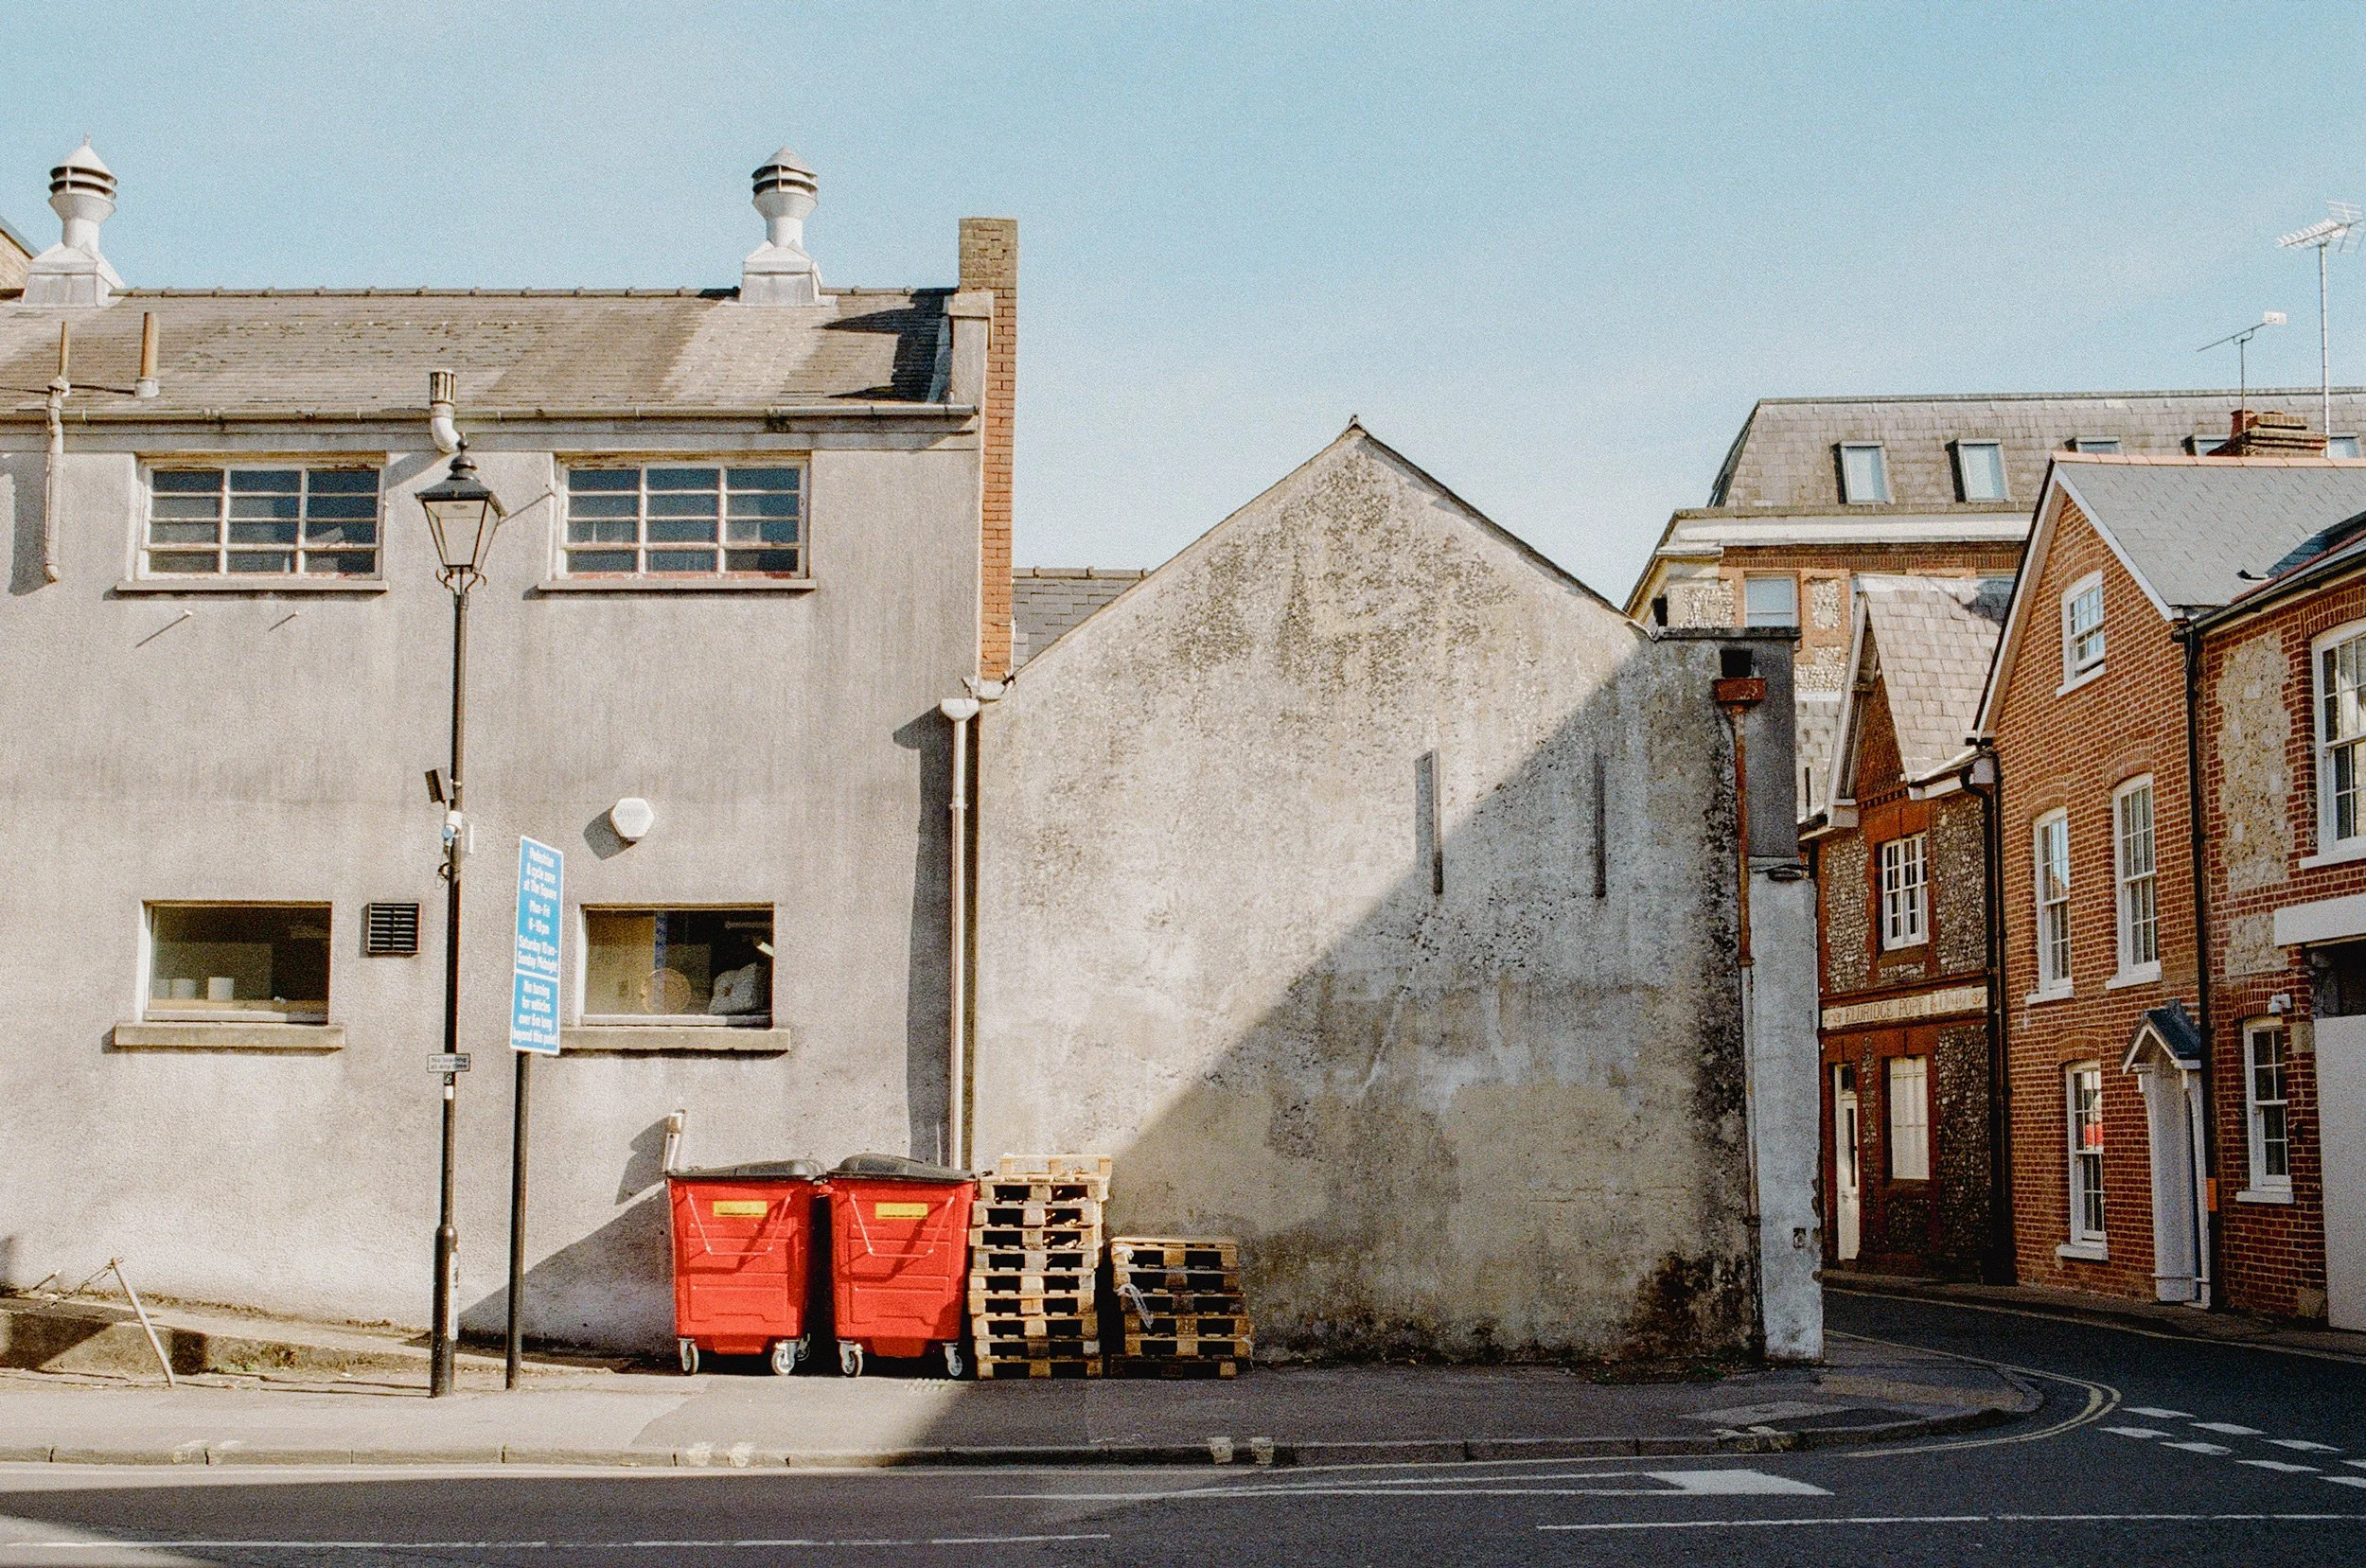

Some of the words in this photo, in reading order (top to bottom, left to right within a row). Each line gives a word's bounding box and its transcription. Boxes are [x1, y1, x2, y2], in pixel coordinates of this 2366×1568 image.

[518, 950, 537, 969] Sunday
[523, 979, 532, 994] No
[521, 995, 530, 1009] for
[531, 998, 551, 1013] vehicles
[1898, 996, 1925, 1016] POPE
[518, 1013, 531, 1025] over
